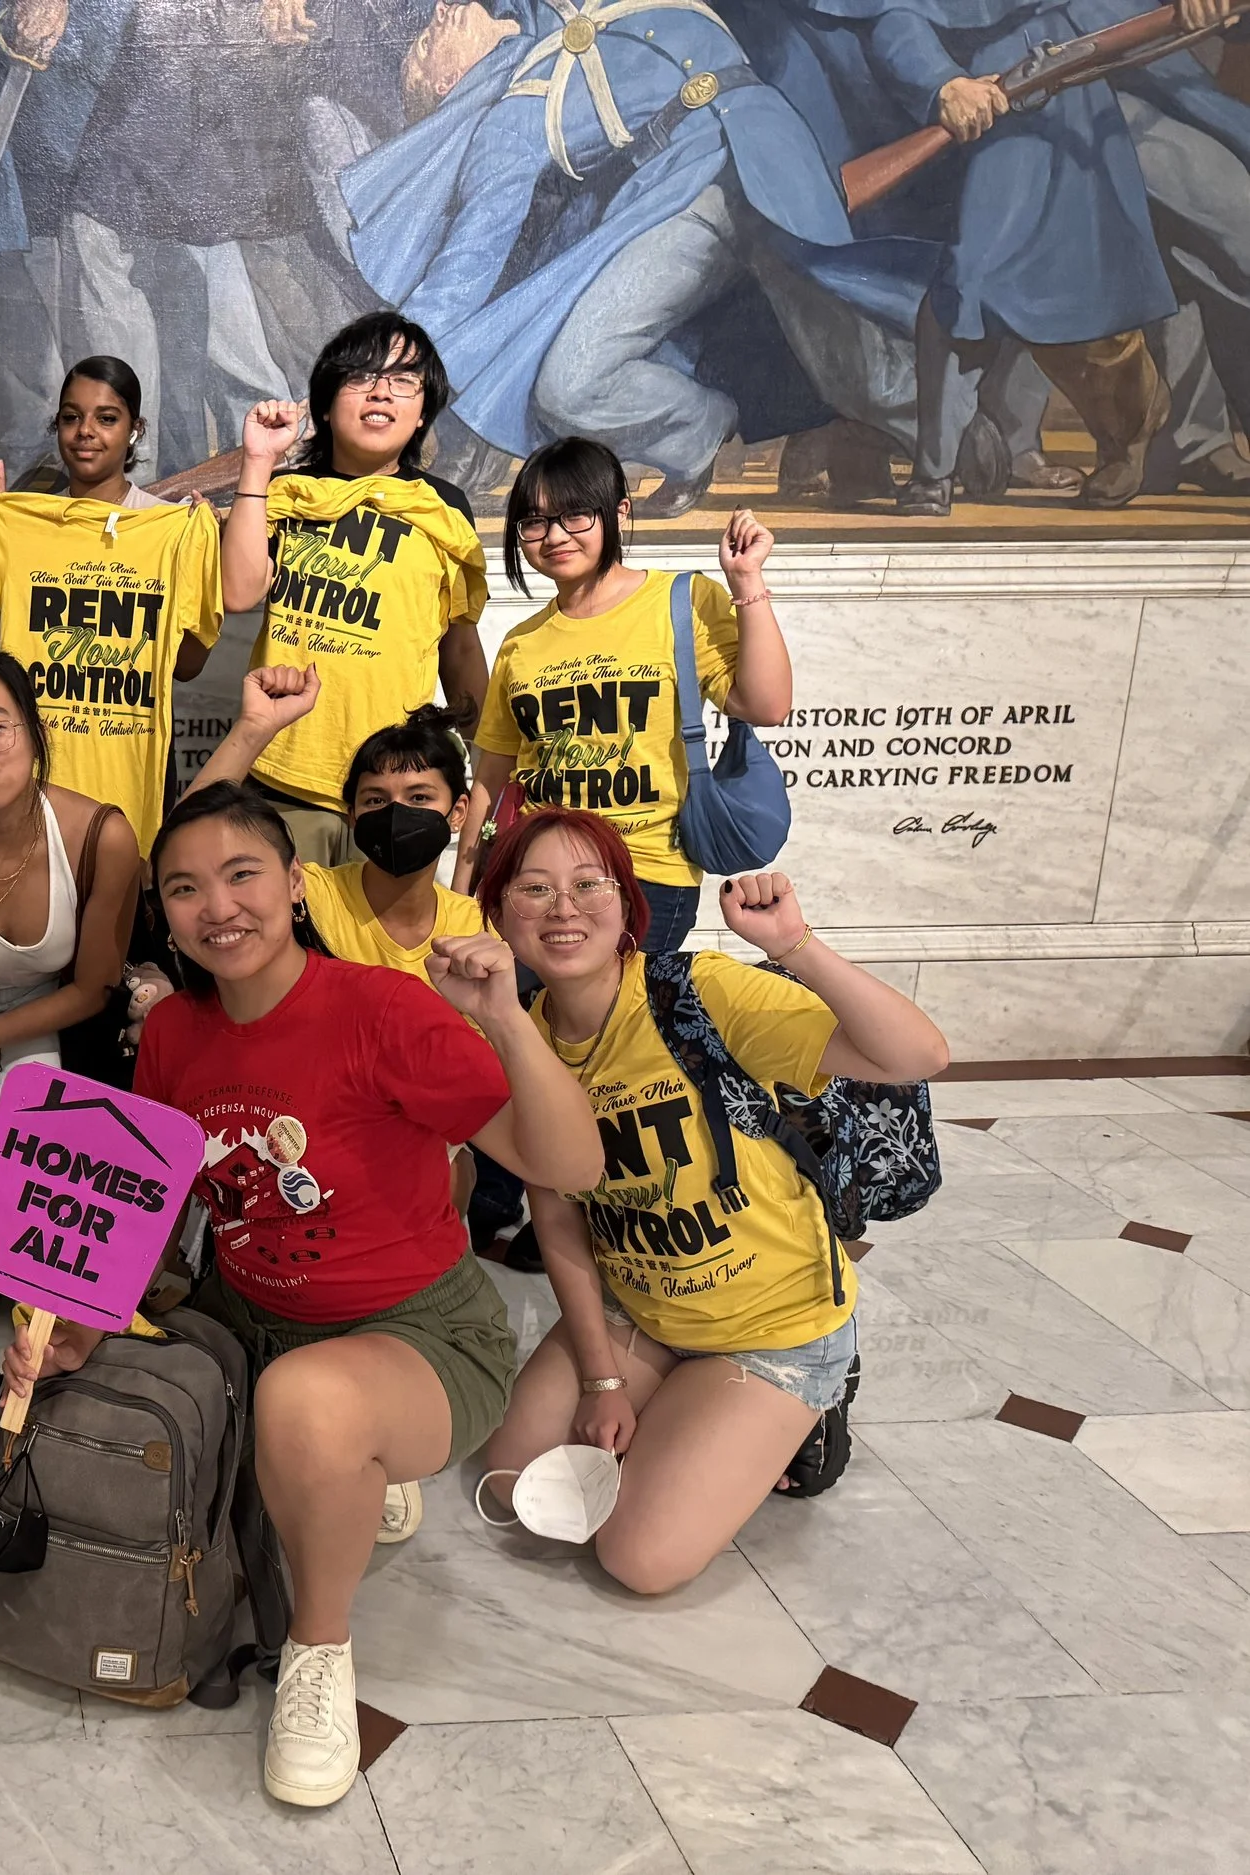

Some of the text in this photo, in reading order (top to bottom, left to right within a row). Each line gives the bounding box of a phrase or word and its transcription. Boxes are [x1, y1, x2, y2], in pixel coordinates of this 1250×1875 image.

[29, 586, 164, 641] RENT
[270, 565, 381, 630] ONTROL
[42, 625, 148, 672] Now!
[28, 661, 155, 709] CONTROL
[511, 681, 660, 742] RENT
[785, 704, 1076, 731] ISTORIC 19TH OF APRIL
[822, 738, 876, 758] AND
[886, 736, 1012, 757] CONCORD
[806, 766, 939, 788] CARRYING
[948, 764, 1074, 786] FREEDOM
[204, 1103, 245, 1118] DEFENSA
[596, 1096, 693, 1181] NT
[1, 1128, 168, 1213] HOMES
[17, 1180, 117, 1244] FOR
[10, 1226, 100, 1283] ALL
